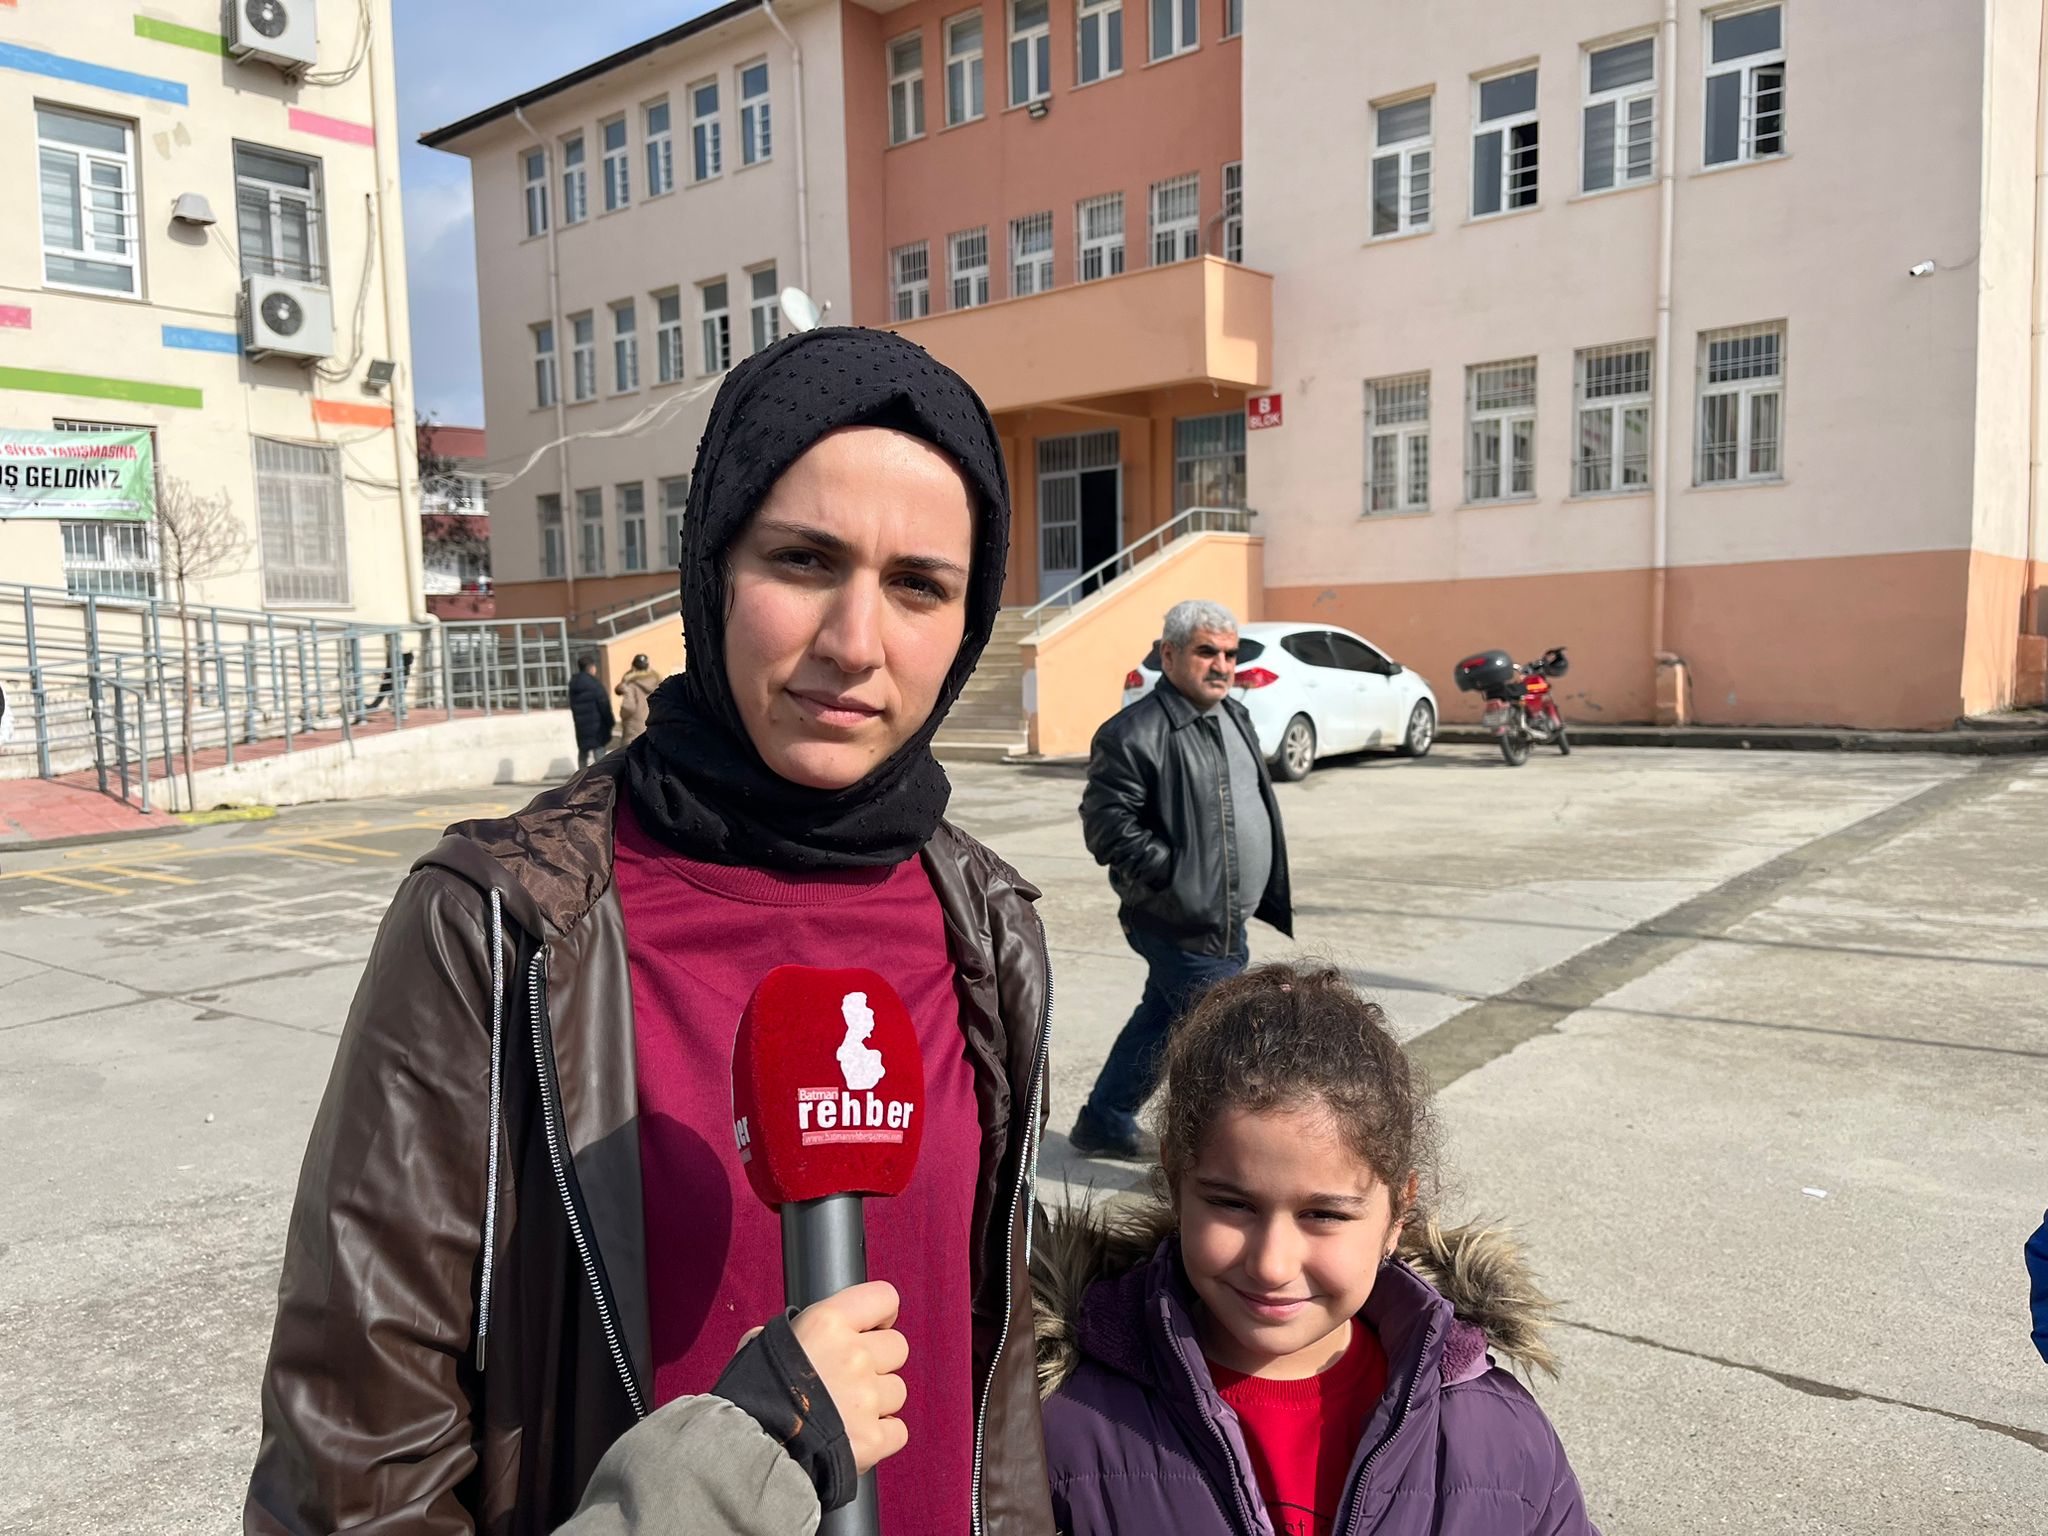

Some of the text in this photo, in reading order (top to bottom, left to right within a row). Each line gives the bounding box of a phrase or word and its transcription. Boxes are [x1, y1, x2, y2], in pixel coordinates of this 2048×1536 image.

[1259, 398, 1270, 413] B
[1249, 413, 1281, 428] BLOK
[49, 444, 137, 460] YARIŞMASINA
[0, 463, 122, 492] Ş GELDİNİZ
[800, 1088, 838, 1100] Batman
[798, 1091, 914, 1129] rehber
